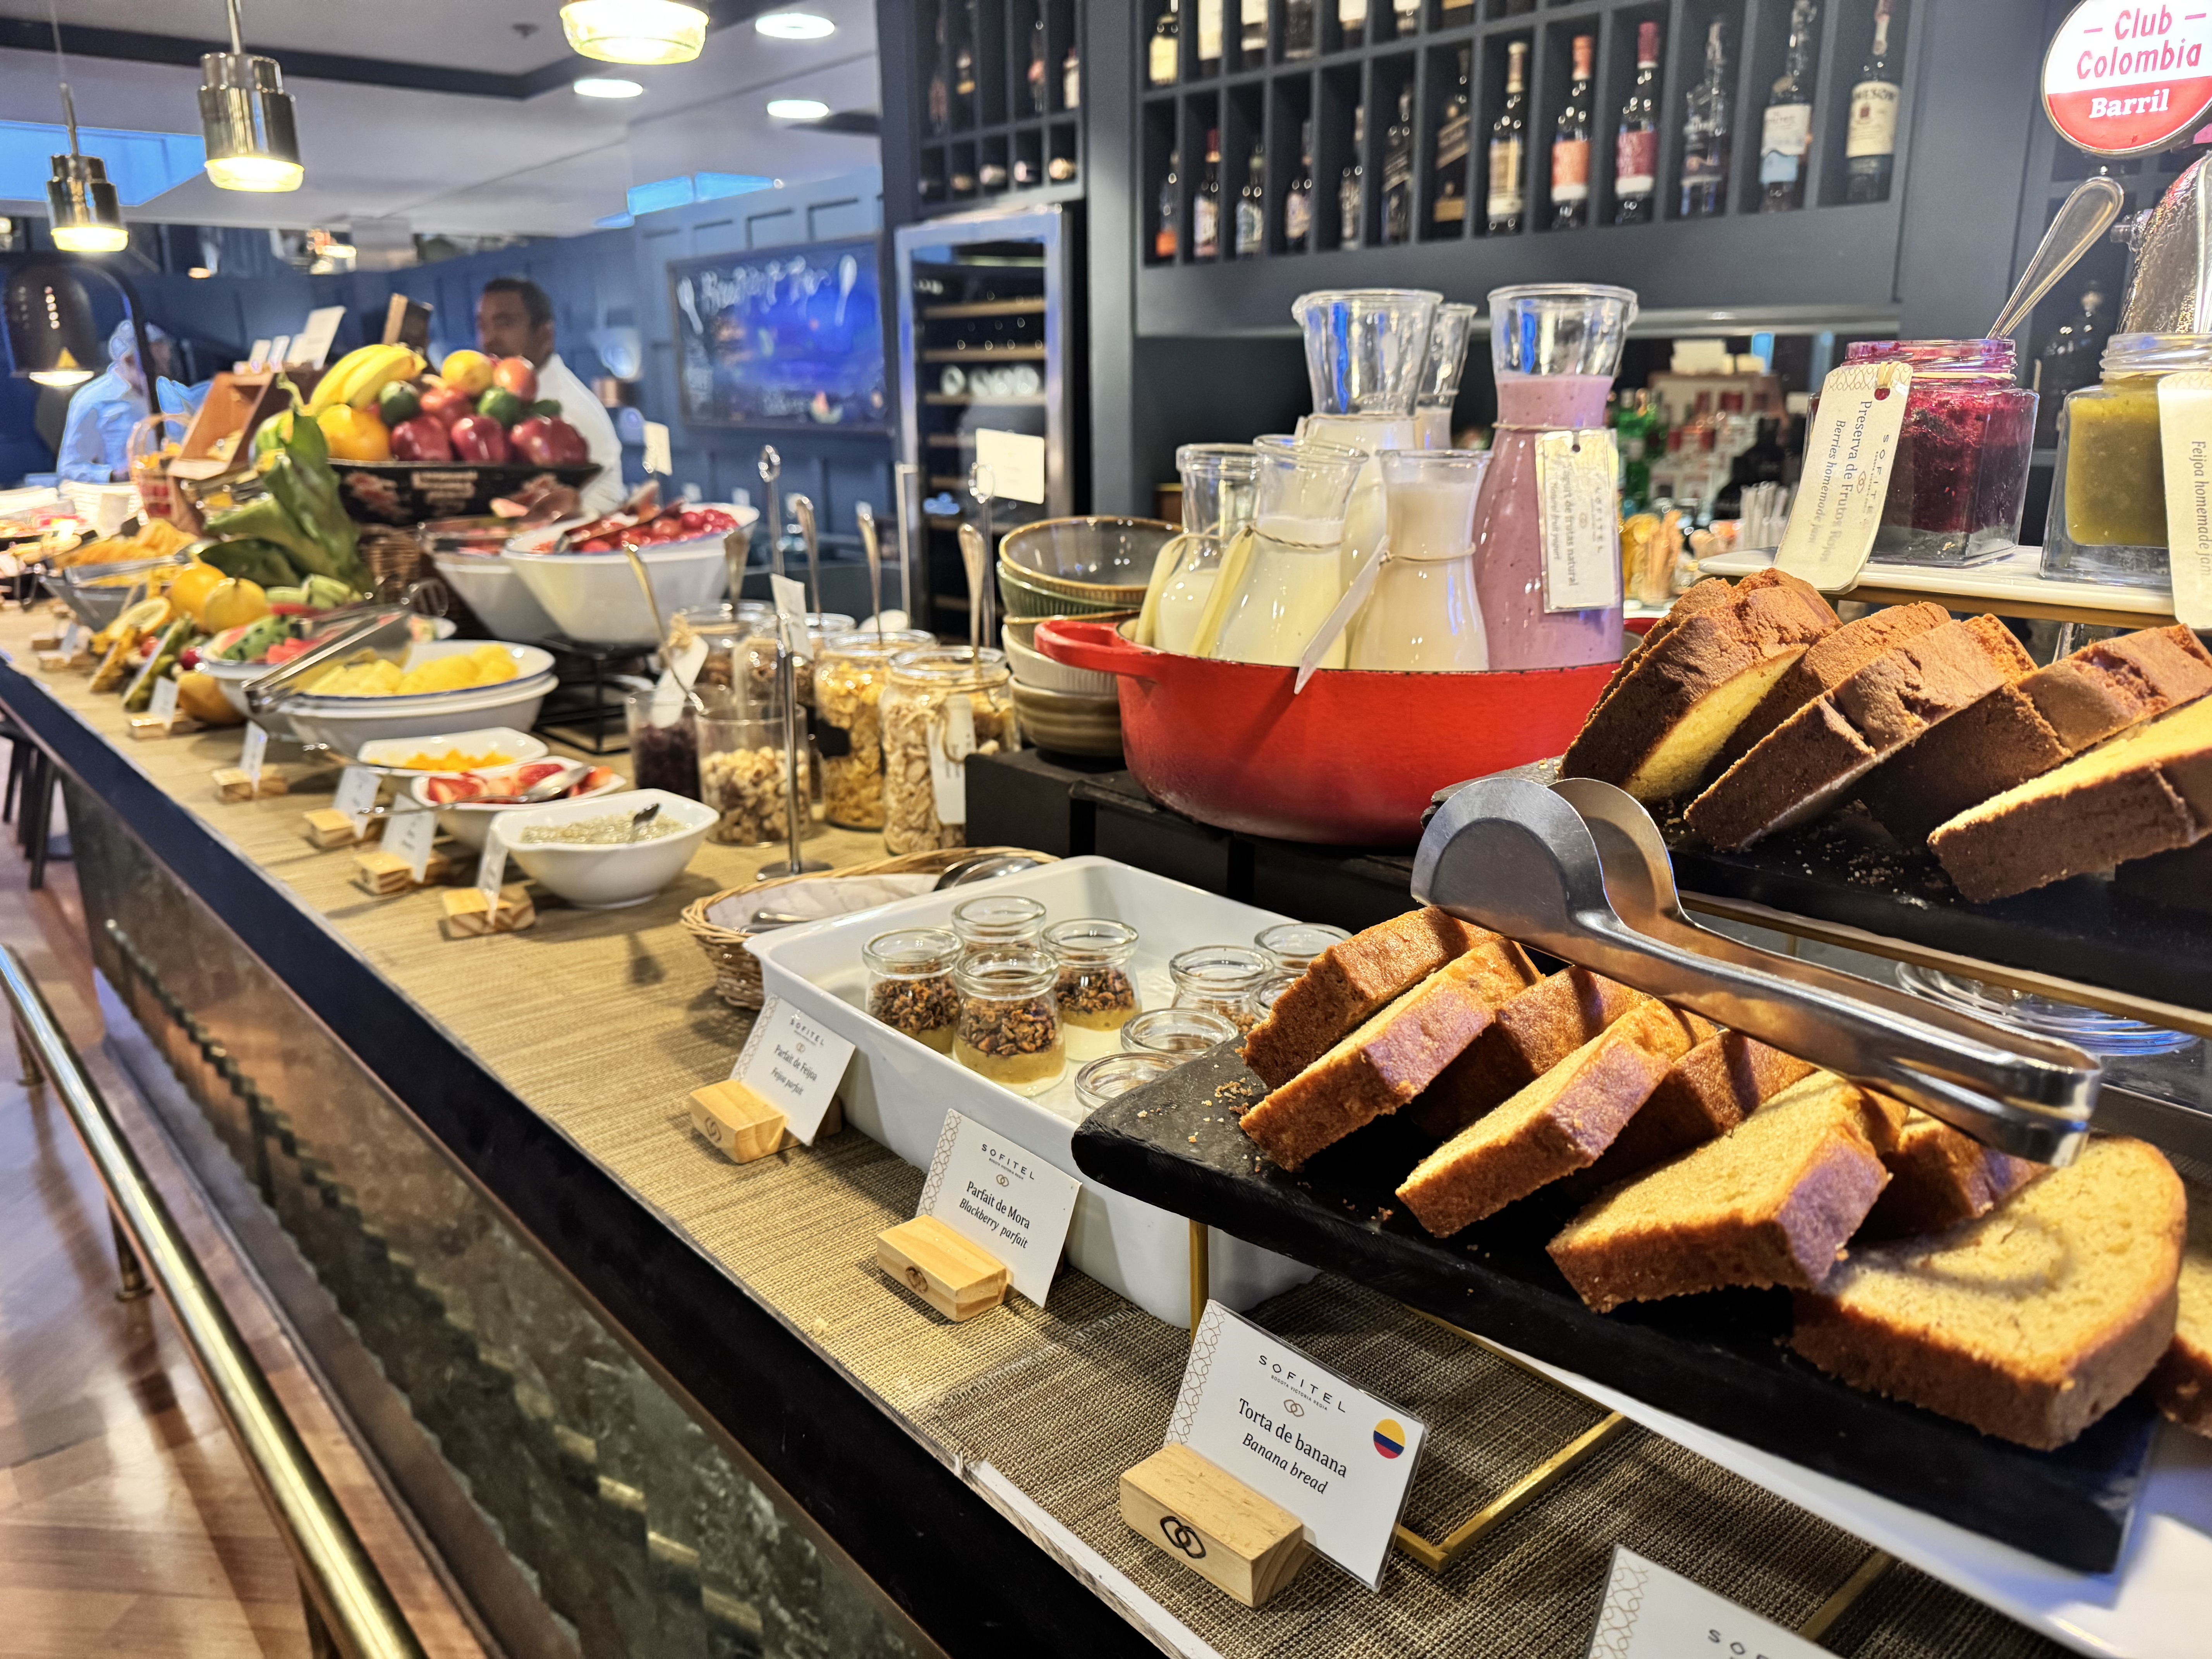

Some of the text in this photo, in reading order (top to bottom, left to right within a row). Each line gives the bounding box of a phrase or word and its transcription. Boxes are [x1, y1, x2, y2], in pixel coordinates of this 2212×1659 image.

[2115, 4, 2172, 40] Club
[2077, 38, 2202, 79] Colombia
[2088, 89, 2169, 118] Barril
[1828, 420, 1846, 459] Berries
[1848, 400, 1872, 459] Preserva
[1814, 461, 1837, 522] homemade
[1844, 464, 1858, 479] de
[1565, 500, 1576, 513] de
[1832, 484, 1853, 527] Frutos
[2189, 441, 2212, 576] Feijoa homemade jam
[1567, 548, 1579, 586] natural
[790, 1018, 824, 1046] SOFITEL
[774, 1044, 817, 1082] Parfait de Feijoa
[982, 1144, 1035, 1180] SOFITEL
[959, 1198, 1029, 1249] Blackberry parfait
[967, 1181, 1030, 1229] Parfait de Mora
[1259, 1355, 1346, 1413] SOFITEL
[1271, 1375, 1328, 1411] BOGOTA VICTORIA REGIA
[1239, 1398, 1347, 1479] Torta de banana
[1242, 1433, 1328, 1495] Banana bread
